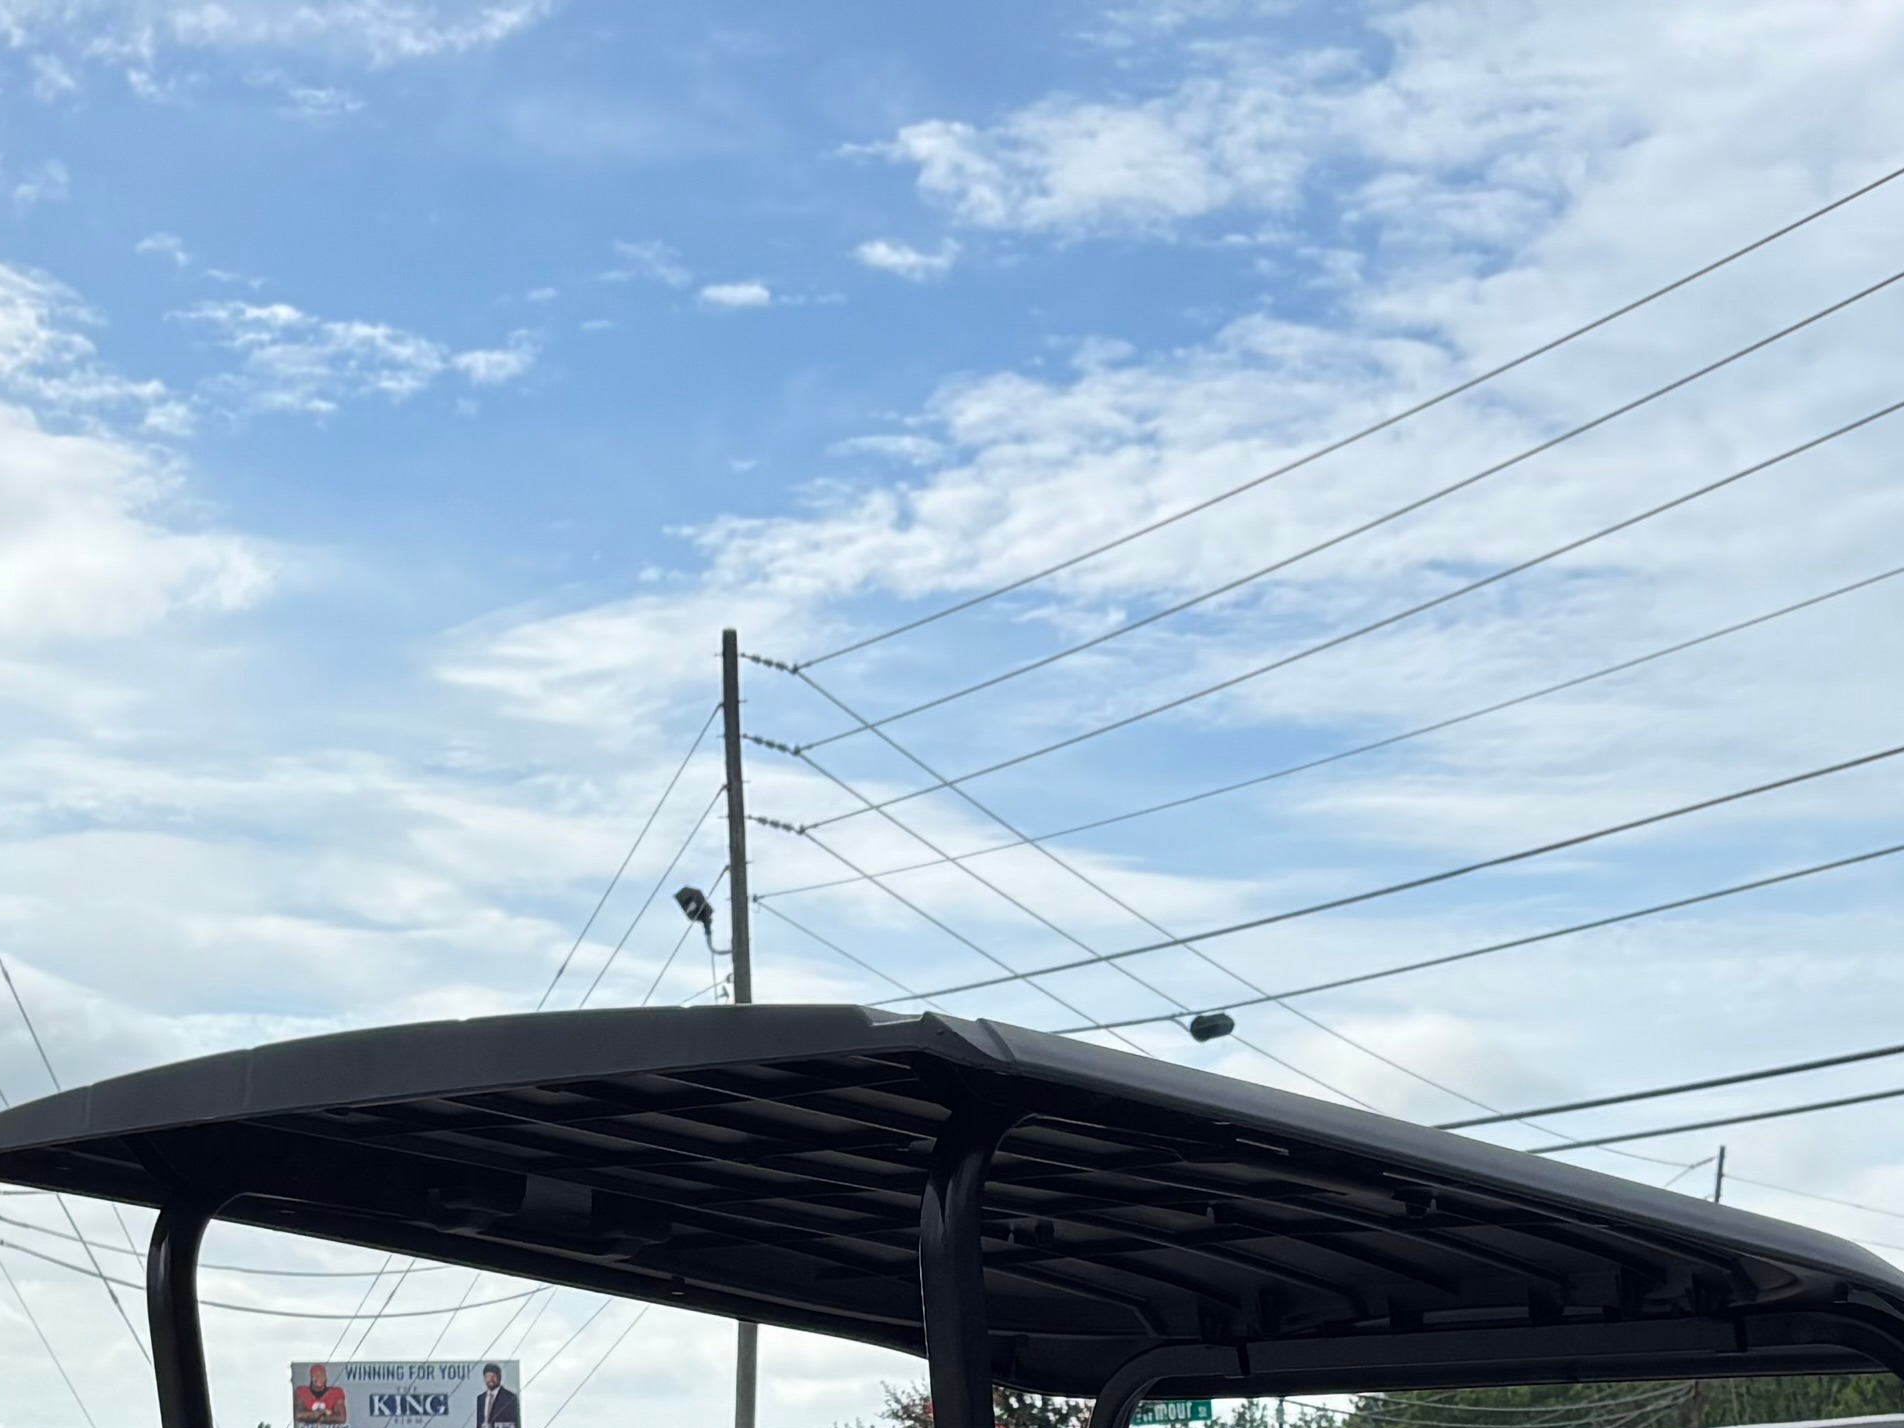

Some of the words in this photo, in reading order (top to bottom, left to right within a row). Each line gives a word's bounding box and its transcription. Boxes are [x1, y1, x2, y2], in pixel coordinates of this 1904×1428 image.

[346, 1365, 404, 1381] WINNING
[409, 1365, 435, 1380] FOR
[439, 1364, 471, 1380] YOU!
[373, 1394, 446, 1416] KING
